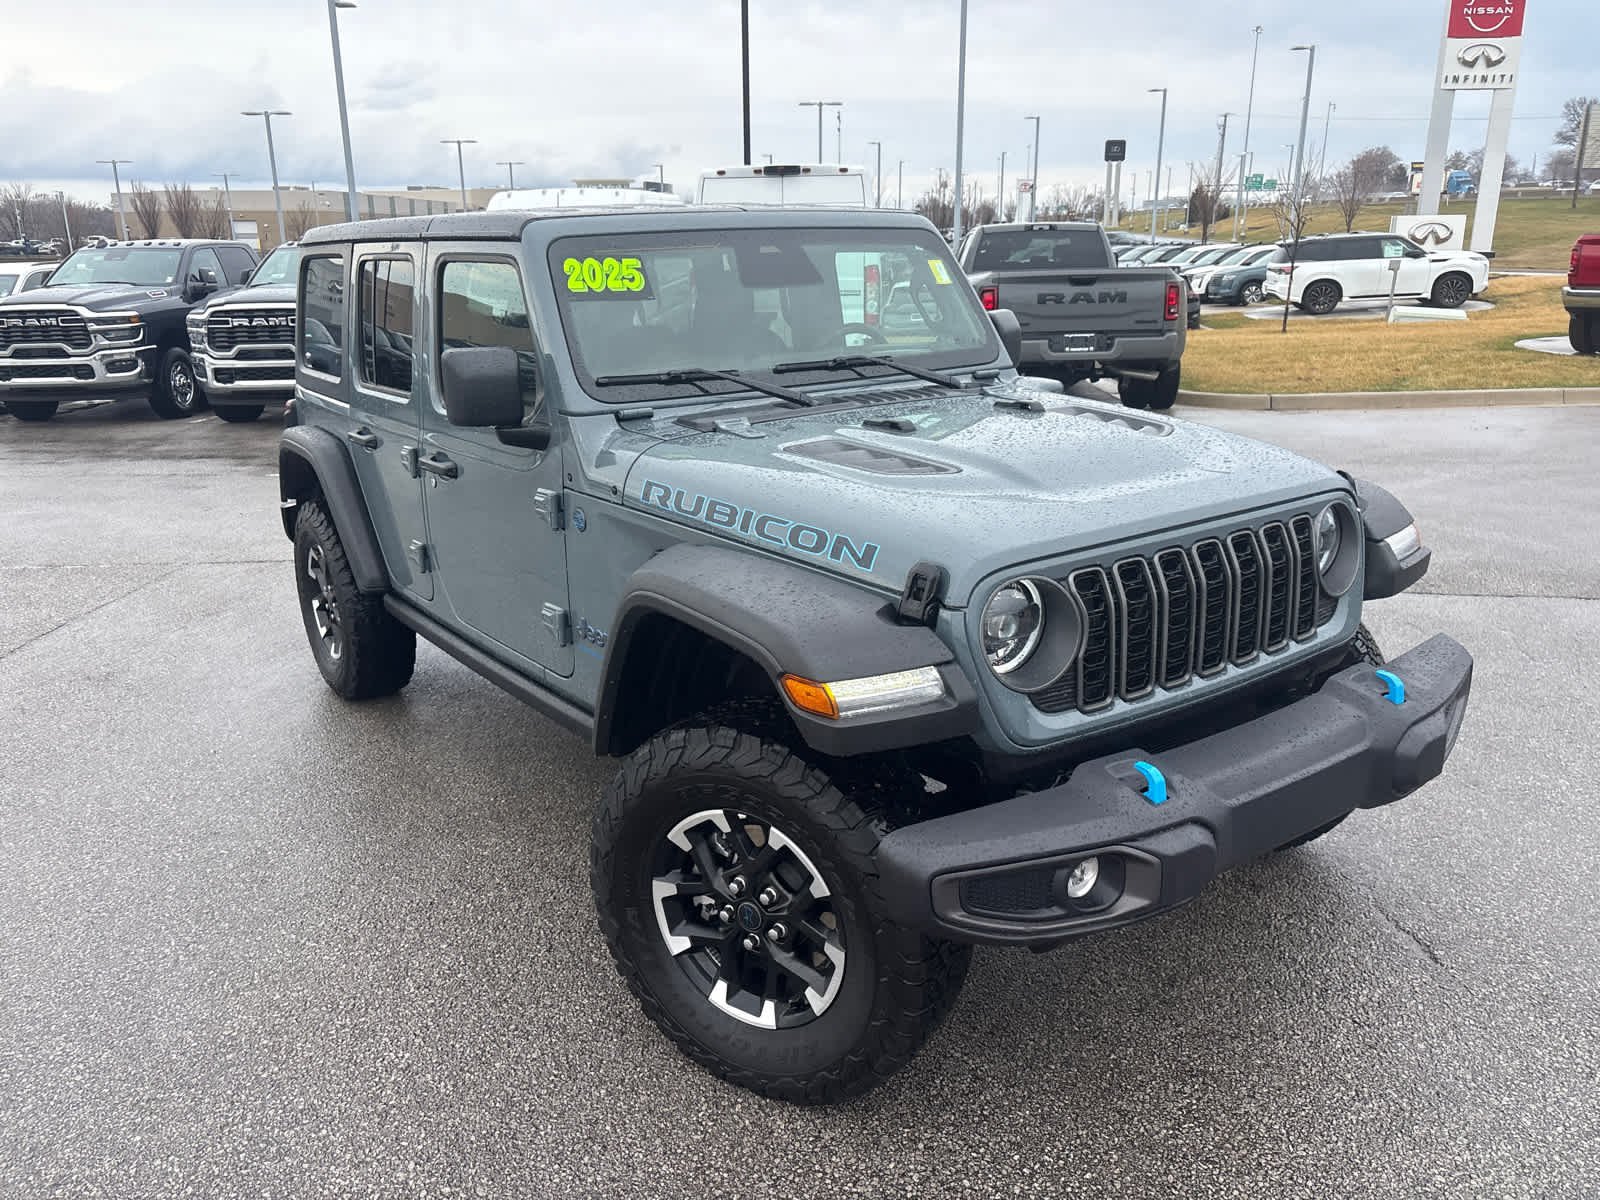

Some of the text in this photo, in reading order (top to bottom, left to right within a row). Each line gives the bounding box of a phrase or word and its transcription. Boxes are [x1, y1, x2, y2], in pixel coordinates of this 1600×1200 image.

[1463, 6, 1514, 15] NISSAN
[1444, 73, 1514, 84] INFINITI
[563, 257, 646, 293] 2025
[1036, 291, 1128, 305] RAM
[8, 317, 57, 327] RAM
[232, 317, 287, 327] RAM
[641, 479, 881, 572] RUBICON
